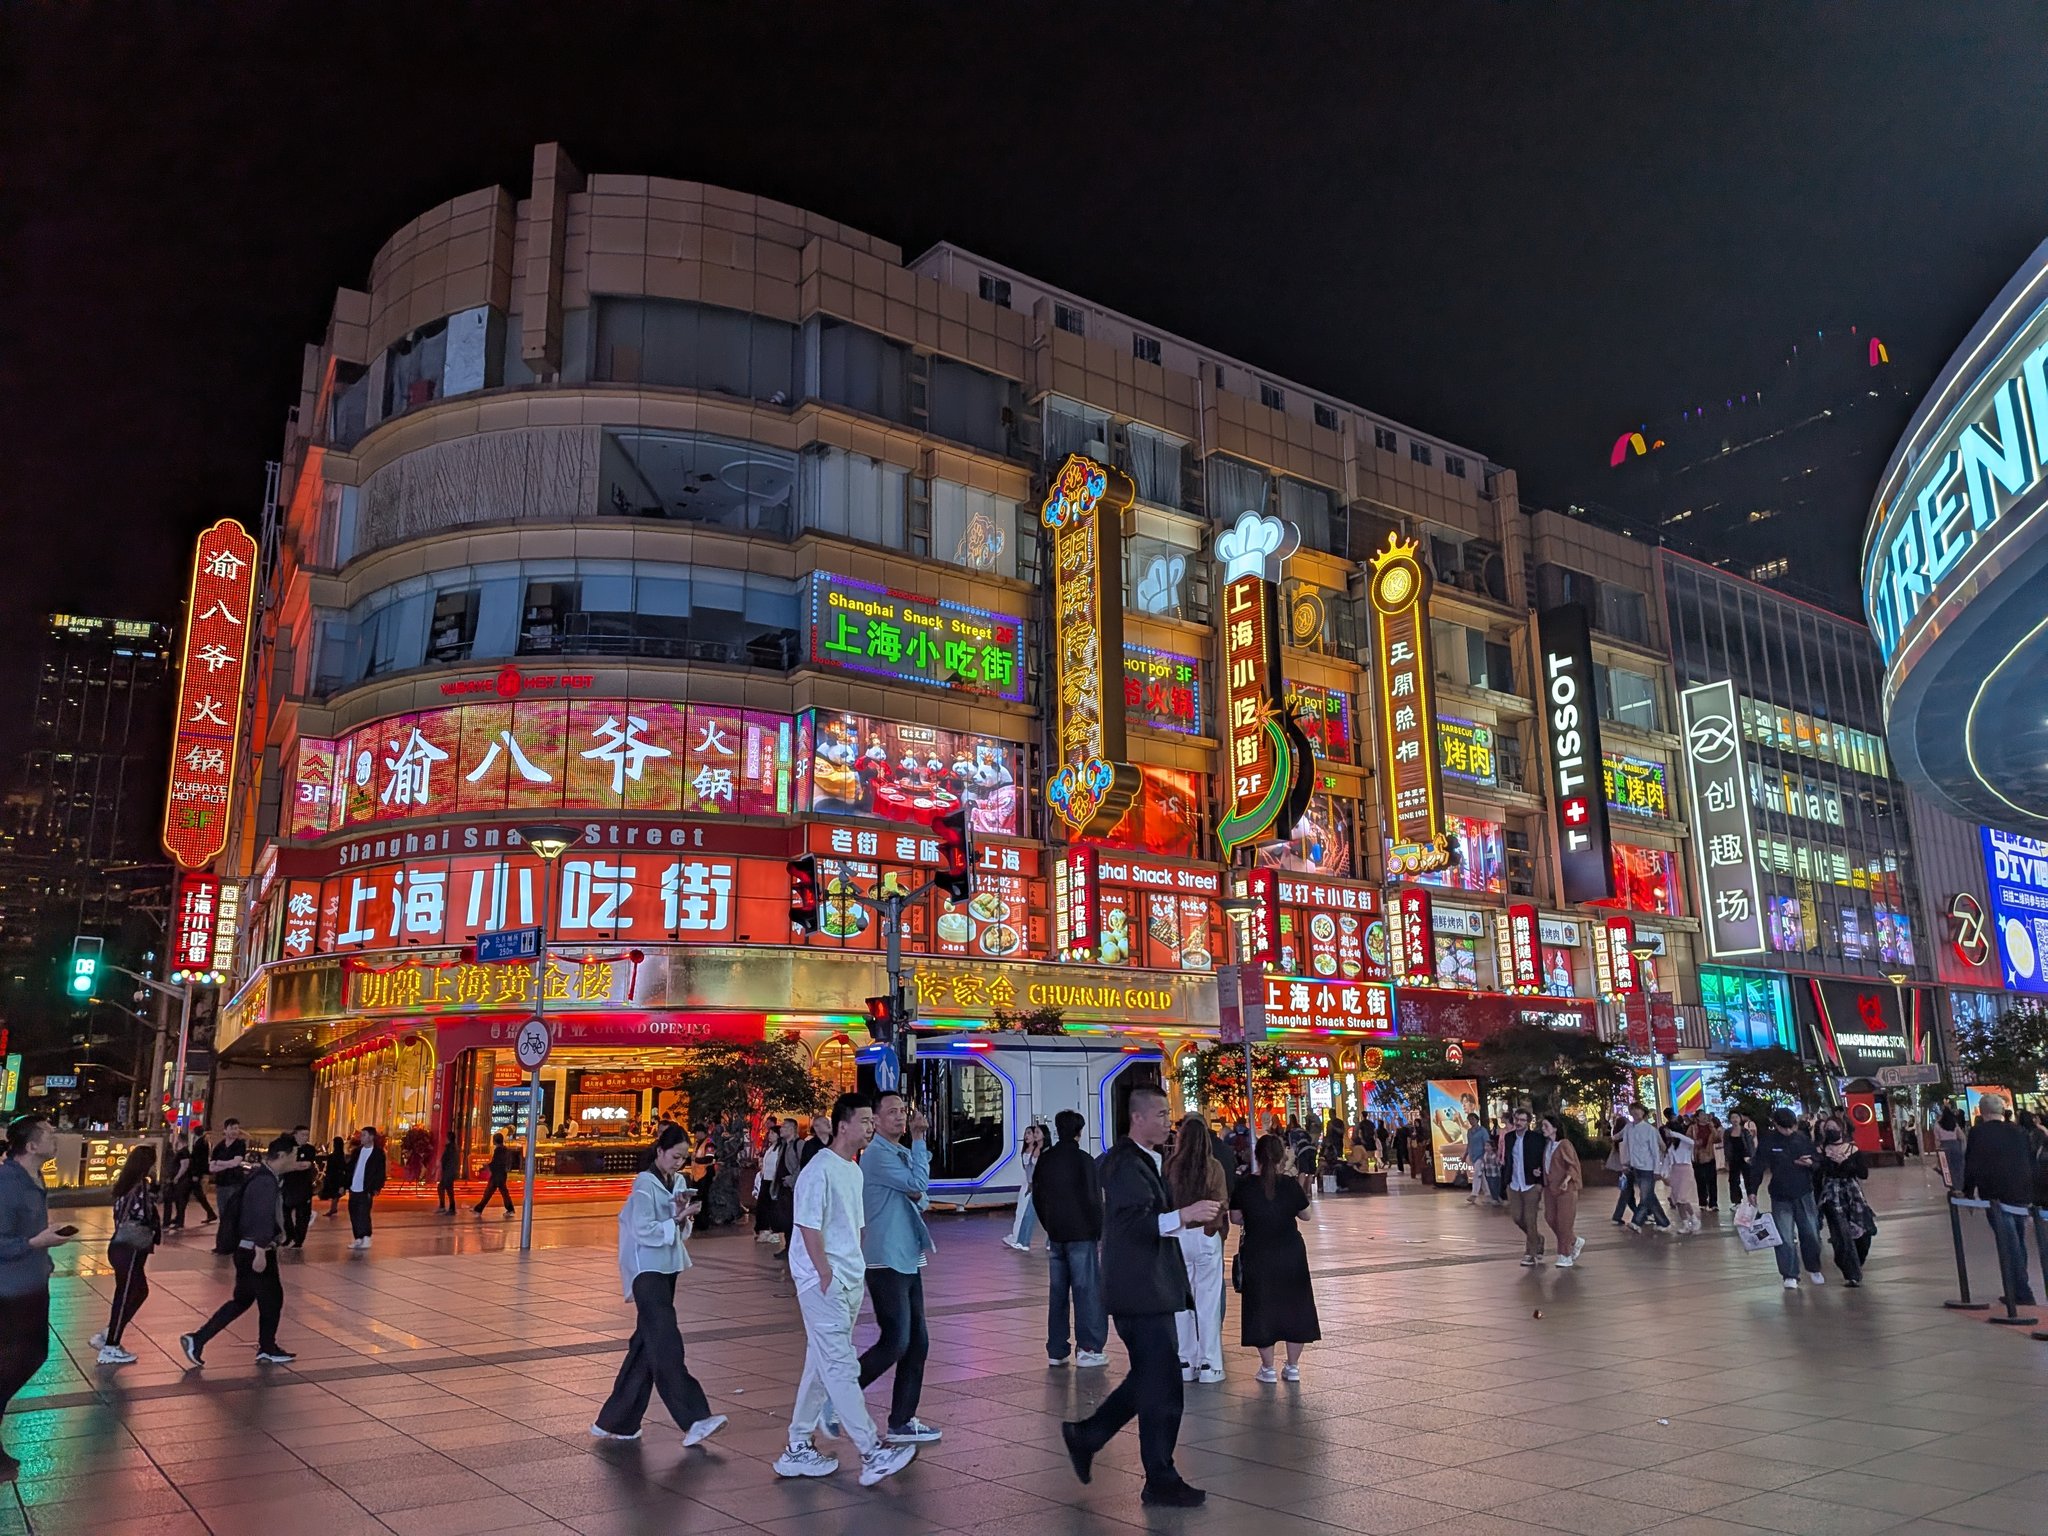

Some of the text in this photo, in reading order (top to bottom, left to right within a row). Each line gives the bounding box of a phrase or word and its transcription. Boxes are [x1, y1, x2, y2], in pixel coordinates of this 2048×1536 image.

[828, 592, 1013, 644] Shanghai Snack Street 2F
[183, 549, 246, 775] 渝八爷火锅
[825, 613, 1013, 685] 上海小吃街
[524, 676, 556, 689] HOT
[561, 676, 594, 689] POT
[1124, 659, 1192, 683] HOT POT 3F
[1230, 583, 1258, 765] 上海小吃街
[1124, 677, 1195, 719] 爷火锅
[1304, 696, 1323, 710] POT
[1327, 697, 1341, 713] 3F
[1389, 643, 1419, 763] 王開照相
[1441, 723, 1473, 738] BARBECUE
[1549, 652, 1585, 796] TISSOT
[692, 720, 734, 801] 火锅
[796, 758, 808, 779] 3F
[1444, 737, 1490, 777] 烤肉
[172, 792, 197, 801] HOT
[174, 781, 229, 793] YUBAYE
[300, 783, 327, 803] 3F
[1237, 774, 1261, 797] 2F
[180, 808, 215, 829] 3F
[340, 828, 450, 866] Shanghai
[585, 823, 705, 847] Street
[832, 829, 877, 856] 老街
[980, 846, 1020, 871] 上海
[1704, 777, 1750, 922] 创趣场
[1132, 866, 1174, 885] Snack
[1178, 871, 1217, 890] Street
[338, 860, 732, 945] 上海小吃街
[1074, 855, 1086, 938] 上海小吃街
[1279, 883, 1372, 910] 必打卡小吃街
[189, 883, 213, 962] 上海小吃街
[216, 888, 236, 967] 百年南京路
[1408, 898, 1423, 965] 渝八爷火锅
[1516, 916, 1533, 974] 朝鲜烤肉
[1029, 983, 1171, 1010] CHUANJIA GOLD
[1265, 982, 1386, 1016] 上海小吃街
[506, 1022, 588, 1038] 盛开业
[594, 1022, 711, 1035] GRAND OPENING
[1265, 1014, 1311, 1027] Shanghai
[1315, 1016, 1345, 1027] Snack
[1347, 1016, 1375, 1028] Street
[1858, 1048, 1895, 1058] SHANGHAI
[1889, 1036, 1906, 1049] STOR
